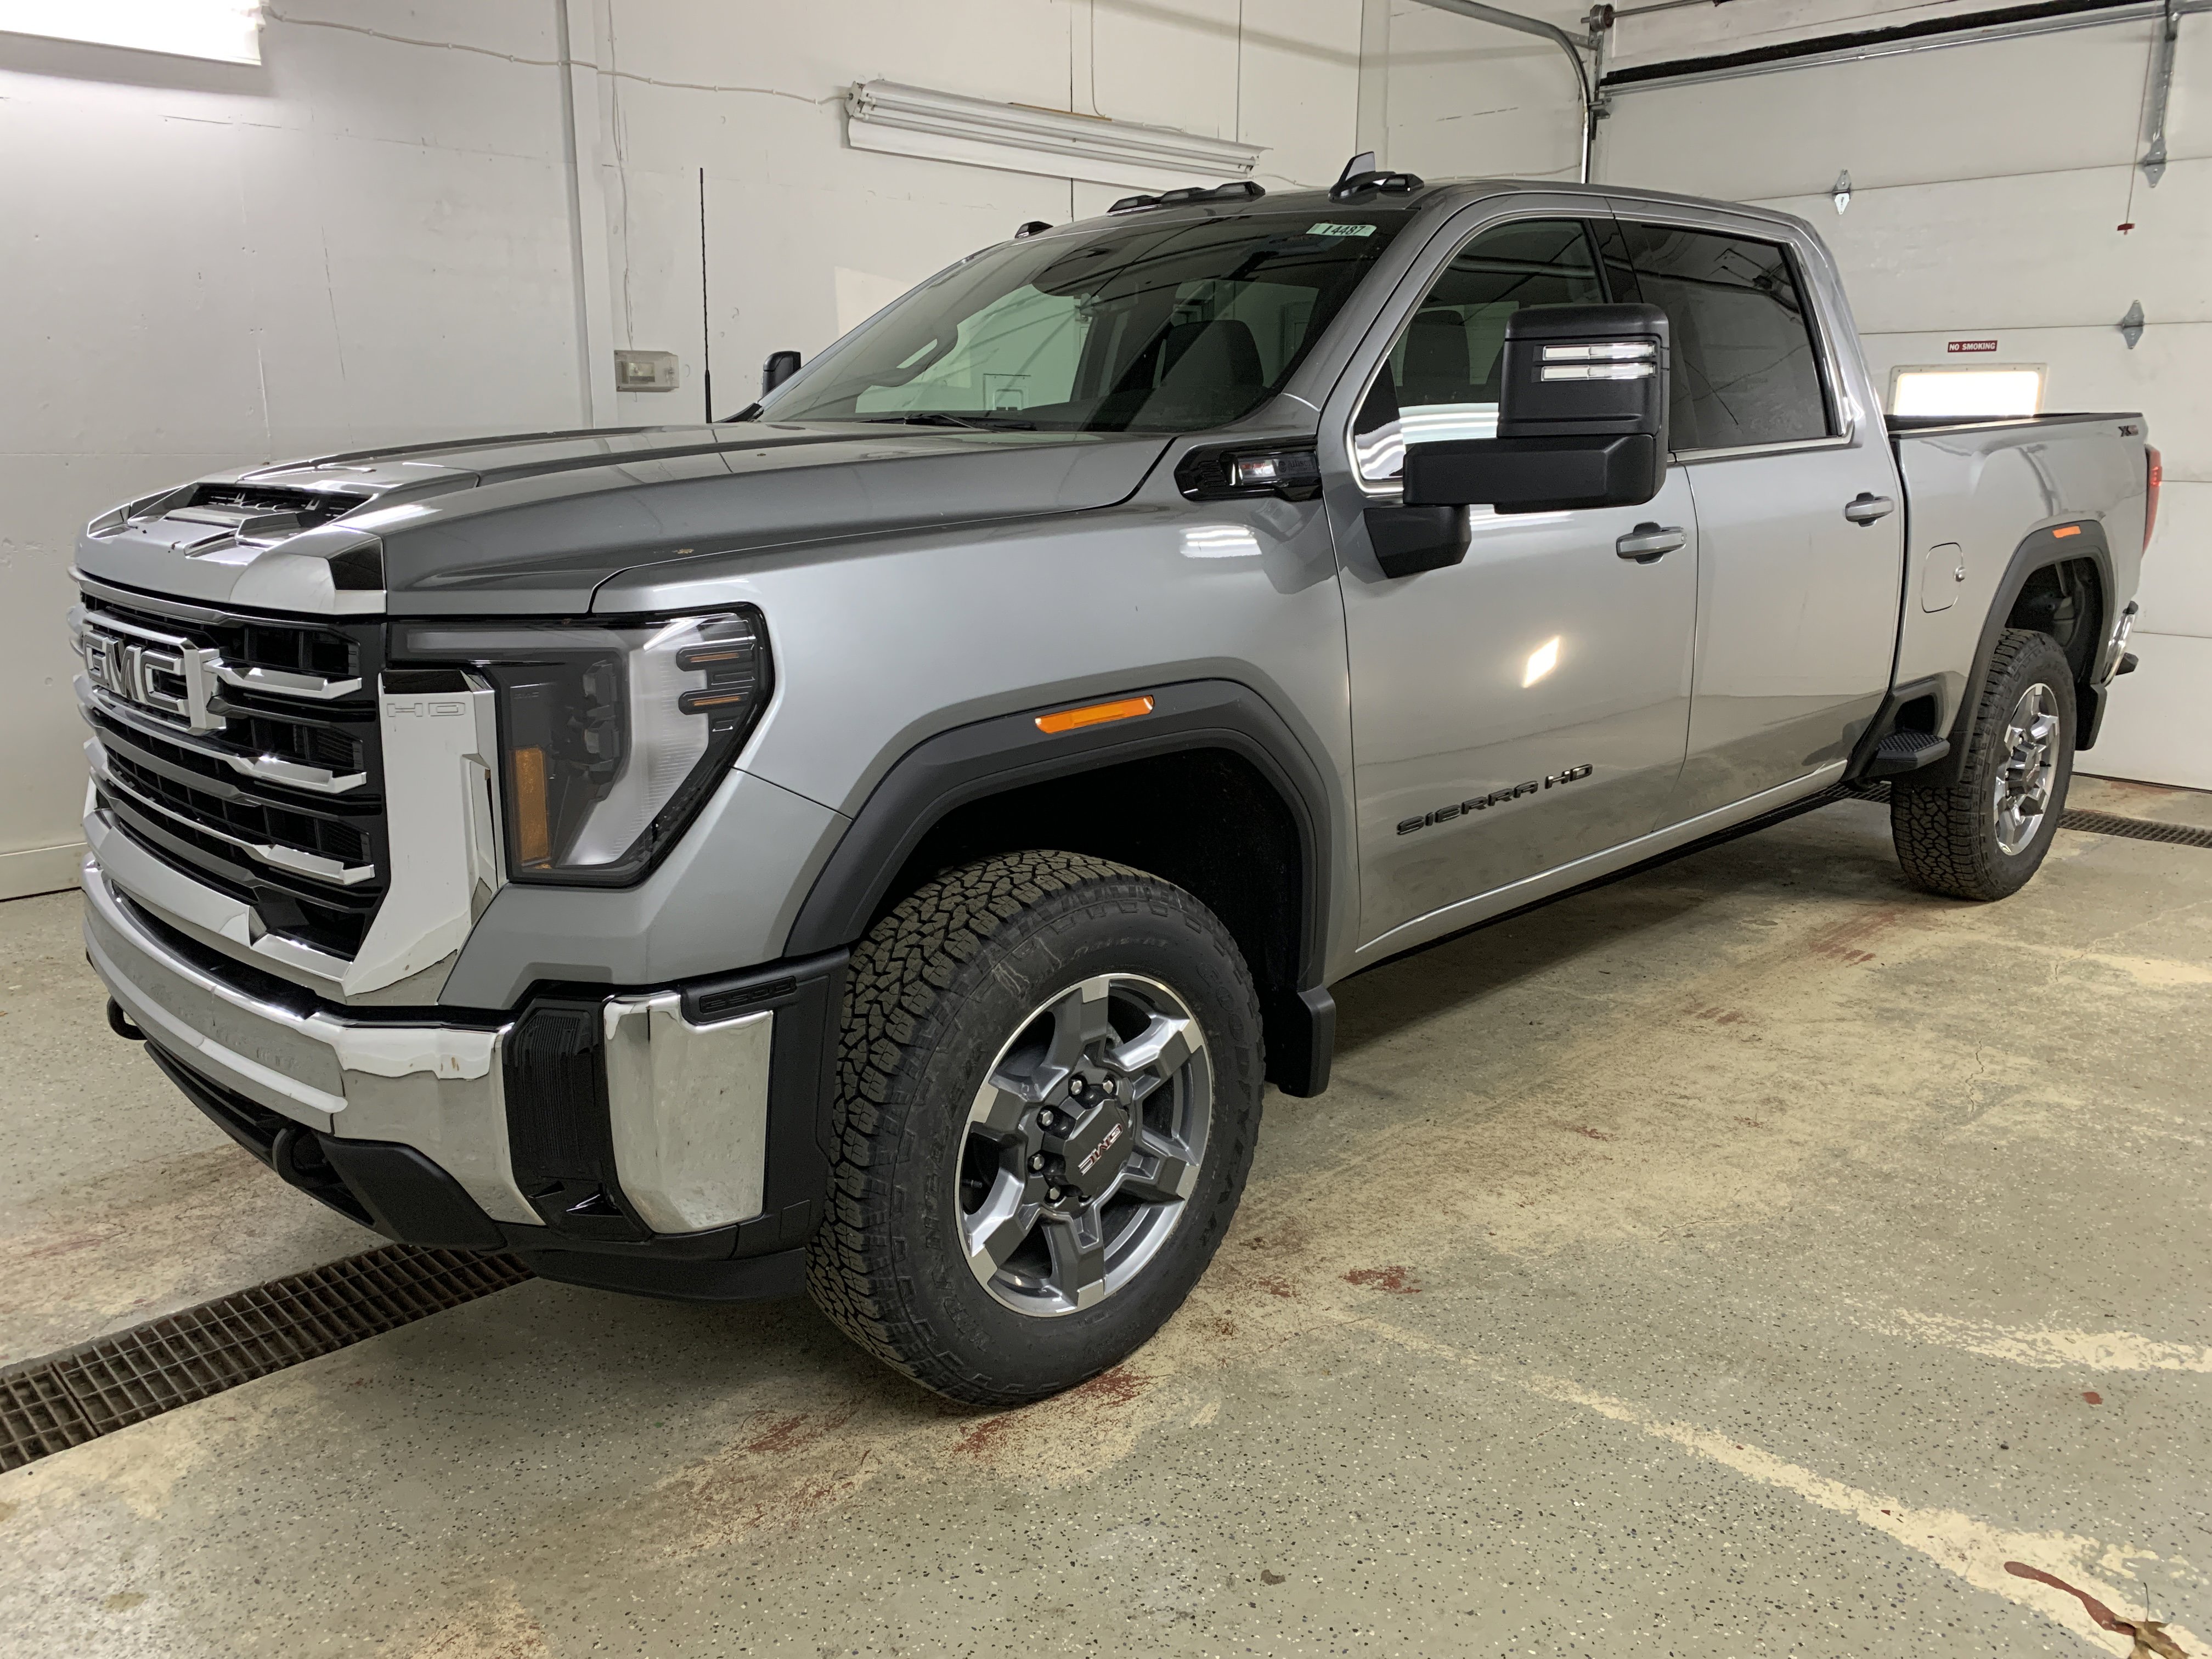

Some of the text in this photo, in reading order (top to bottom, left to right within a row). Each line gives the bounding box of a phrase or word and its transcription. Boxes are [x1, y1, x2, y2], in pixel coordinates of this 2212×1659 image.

[1962, 342, 1996, 351] SMOKING
[83, 630, 189, 717] GMC
[386, 702, 466, 718] HD
[1396, 763, 1593, 836] SIERRA HD
[1077, 1122, 1124, 1177] GMC
